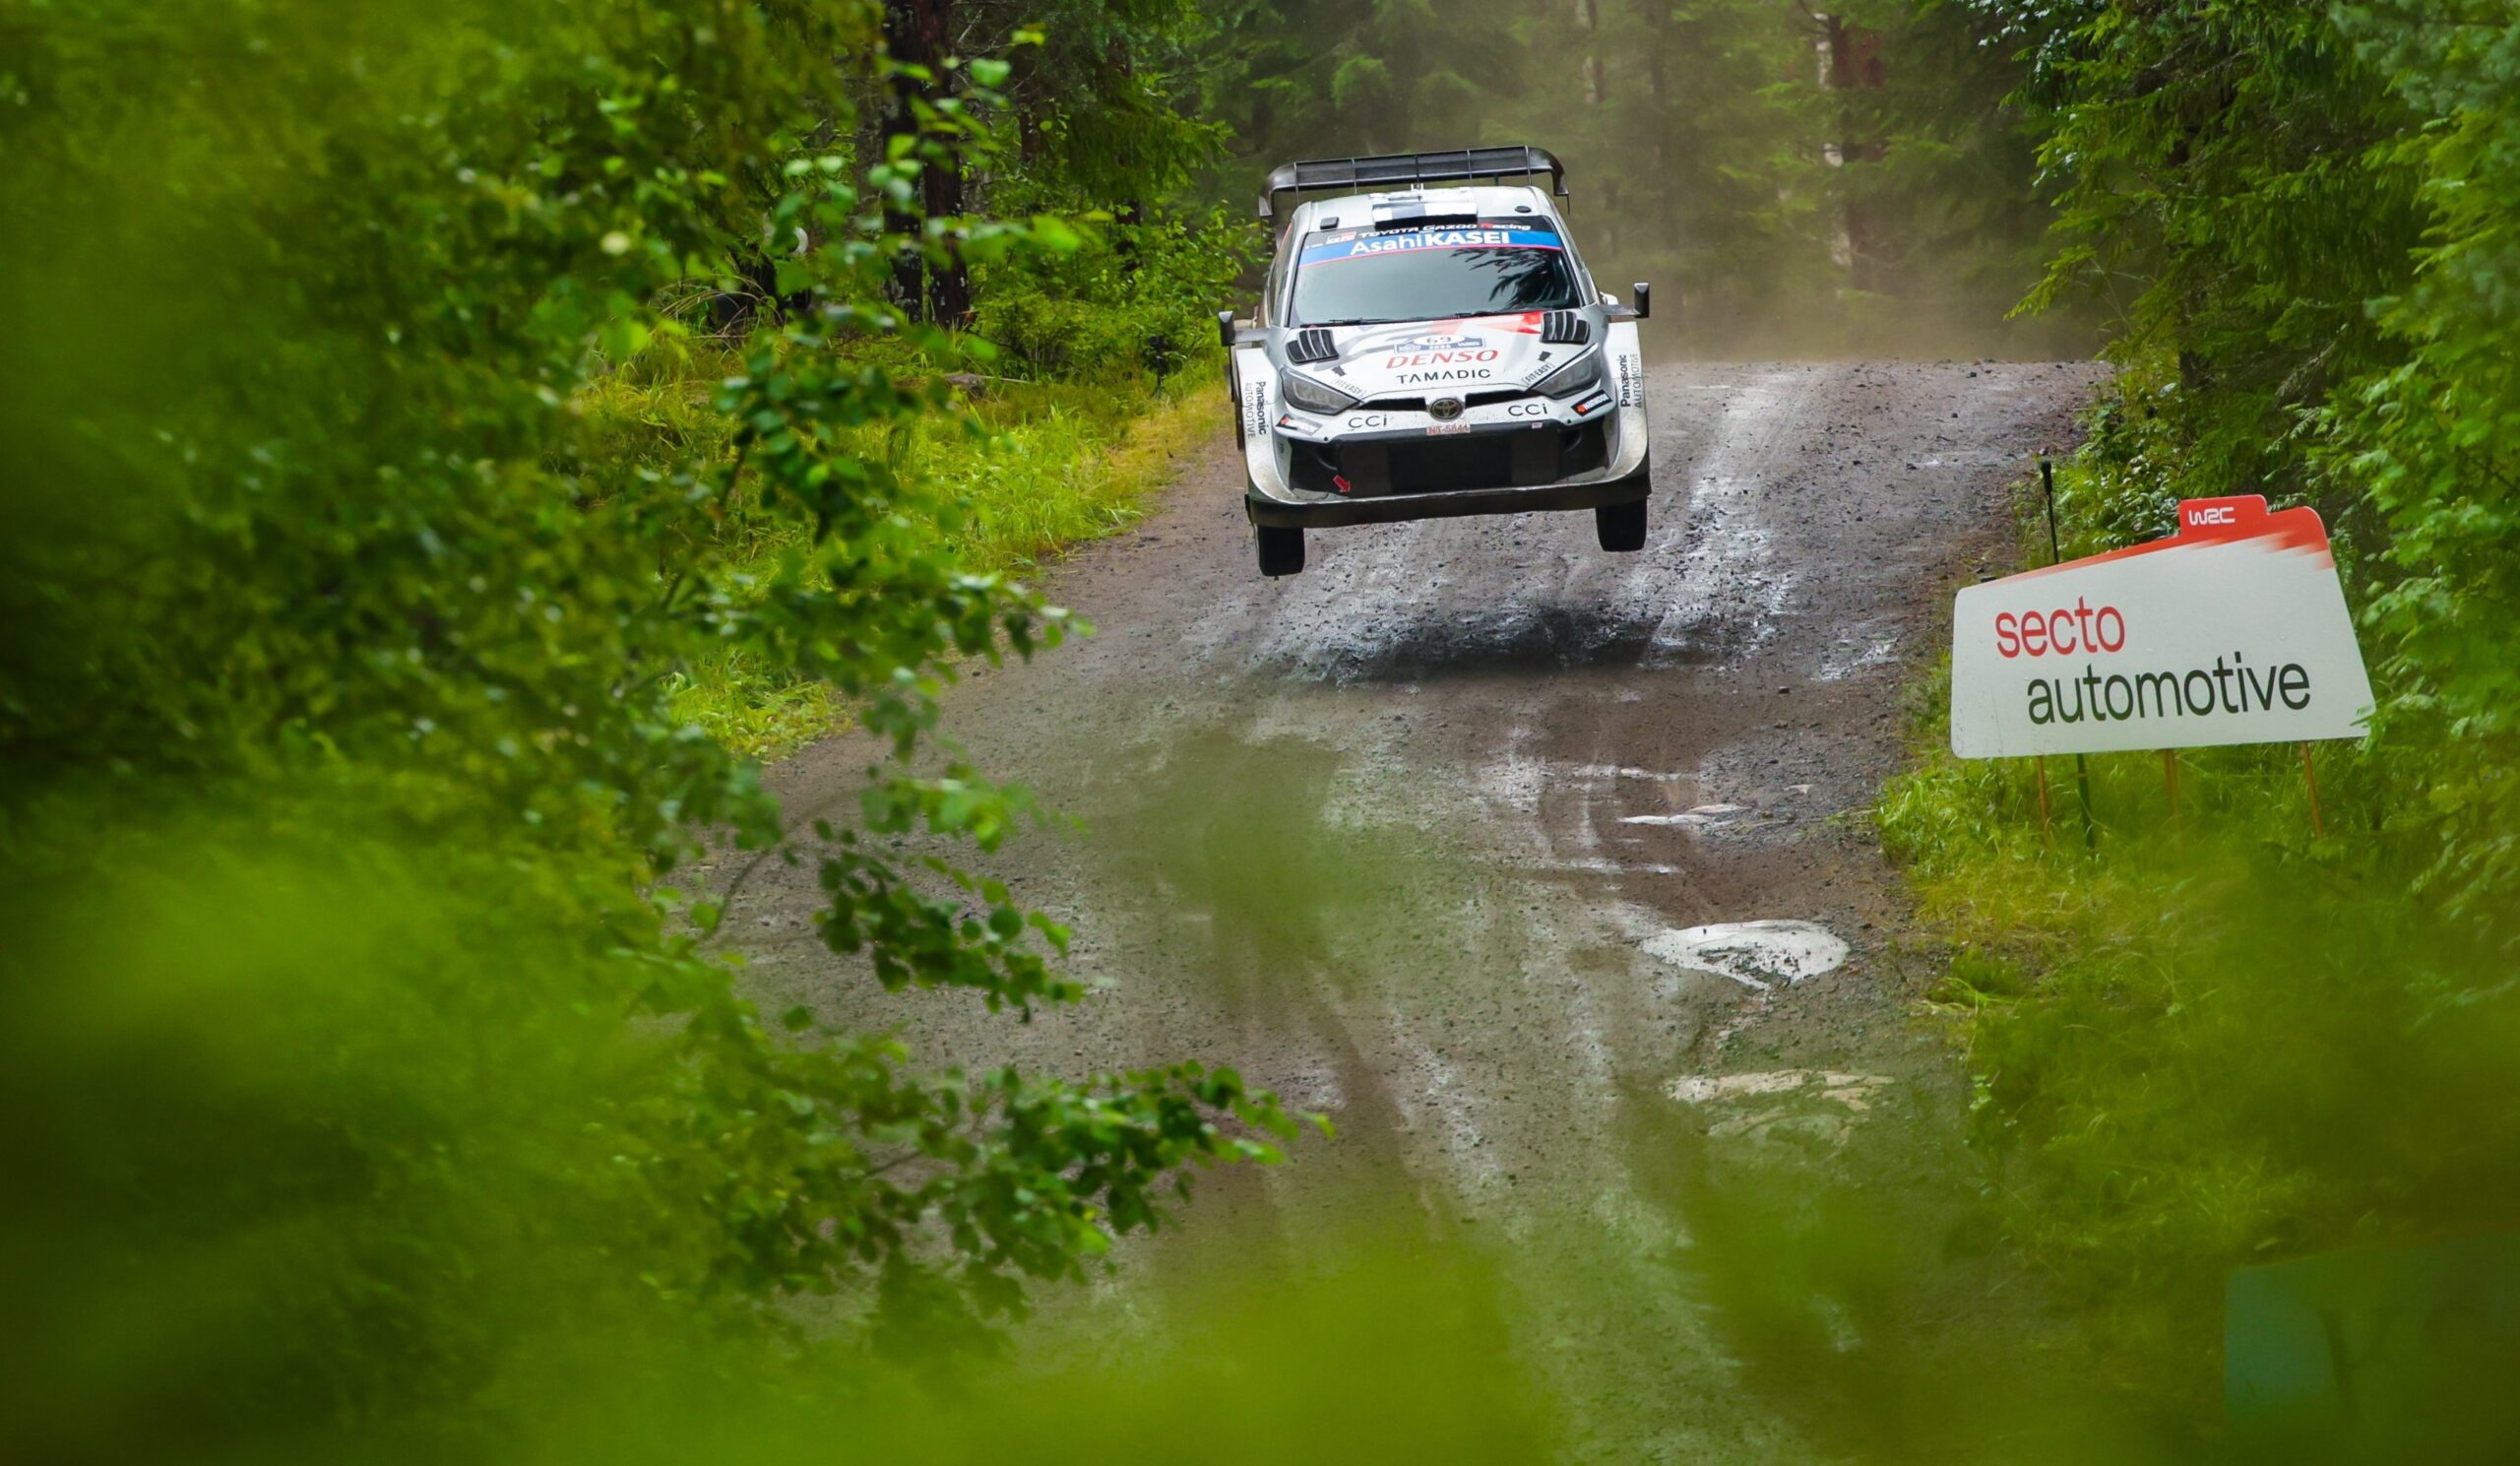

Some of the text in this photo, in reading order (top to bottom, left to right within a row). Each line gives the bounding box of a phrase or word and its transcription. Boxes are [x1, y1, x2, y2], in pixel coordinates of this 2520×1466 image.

[1359, 226, 1418, 238] TOYOTA
[1422, 223, 1477, 232] GAZOO
[1480, 222, 1532, 231] Racing
[1386, 350, 1498, 369] DENSO
[1396, 369, 1491, 384] TAMADIC
[1618, 354, 1631, 408] Panasonic
[1630, 352, 1642, 409] AUTOMOTIVE
[1245, 382, 1256, 439] AUTOMOTIVE
[1256, 381, 1267, 435] Panasonic
[1348, 414, 1387, 428] CCi
[1508, 404, 1547, 416] CCi
[2188, 506, 2236, 526] WRC
[1995, 596, 2125, 658] secto
[2027, 651, 2310, 725] automotive
